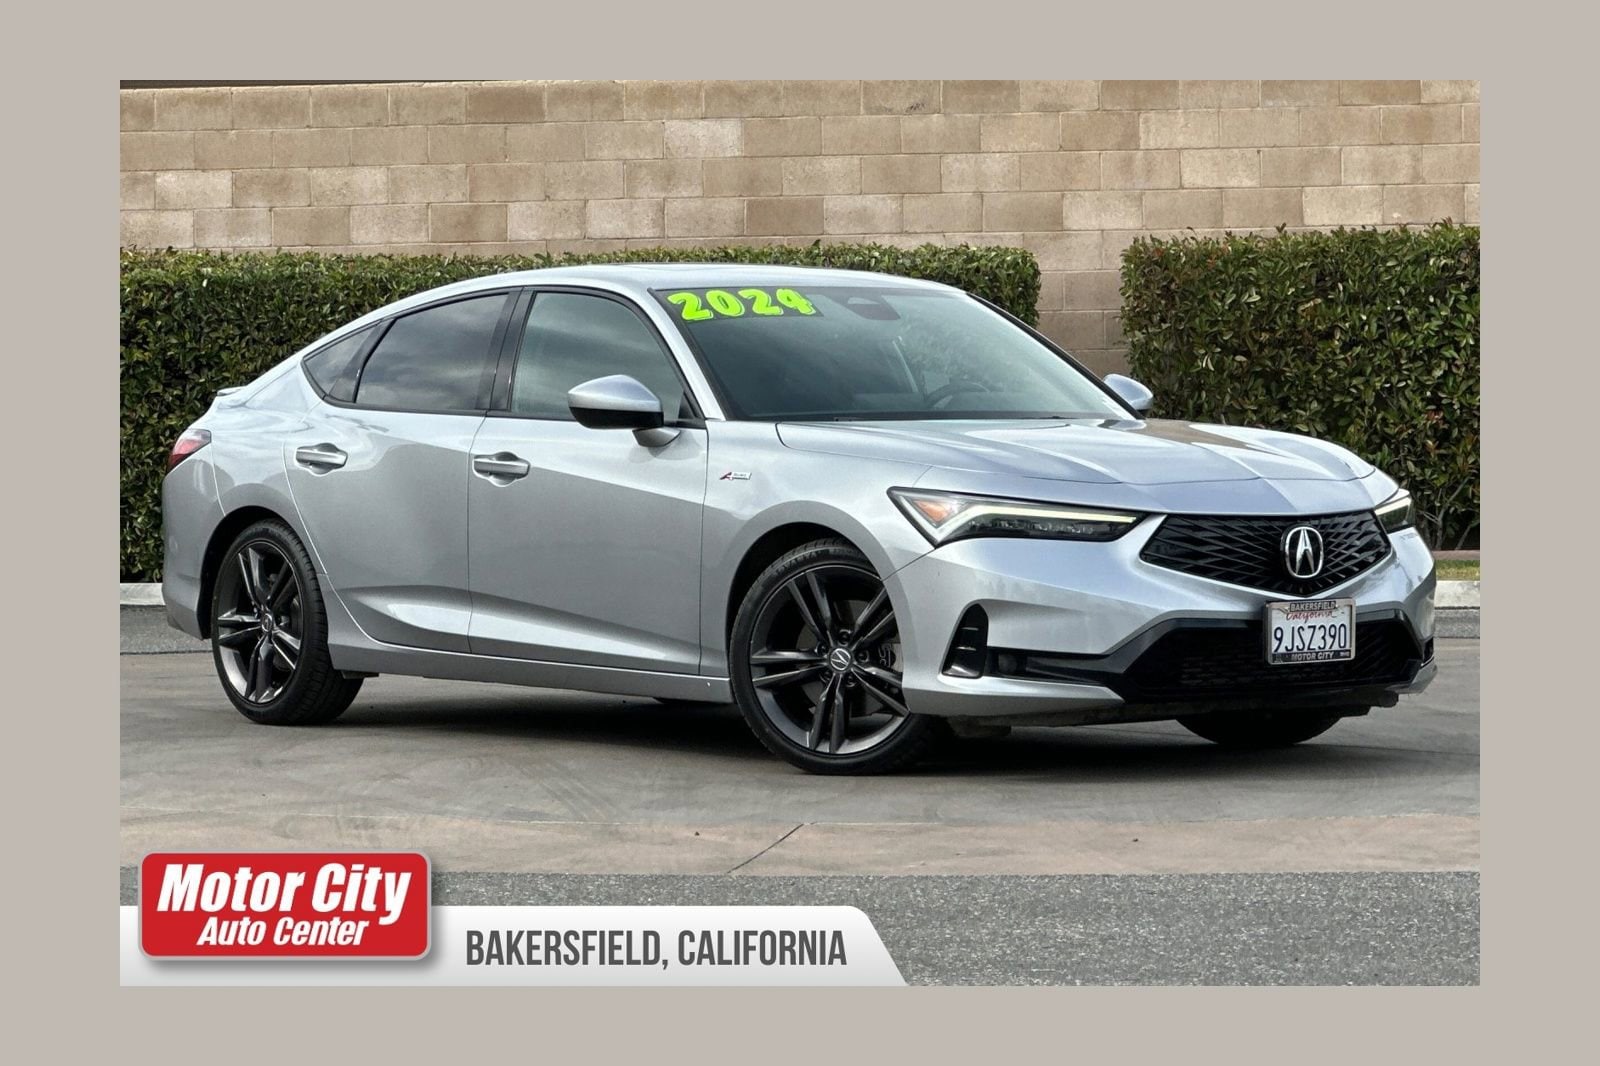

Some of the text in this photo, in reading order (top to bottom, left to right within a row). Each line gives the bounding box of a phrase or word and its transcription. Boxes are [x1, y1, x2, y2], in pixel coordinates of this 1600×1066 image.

[667, 288, 817, 321] 2024
[1291, 602, 1335, 611] BAKERSFIELD
[1286, 611, 1337, 623] California
[1273, 623, 1347, 653] 9JSZ390
[1291, 653, 1316, 661] MOTOR
[1317, 651, 1334, 660] CITY
